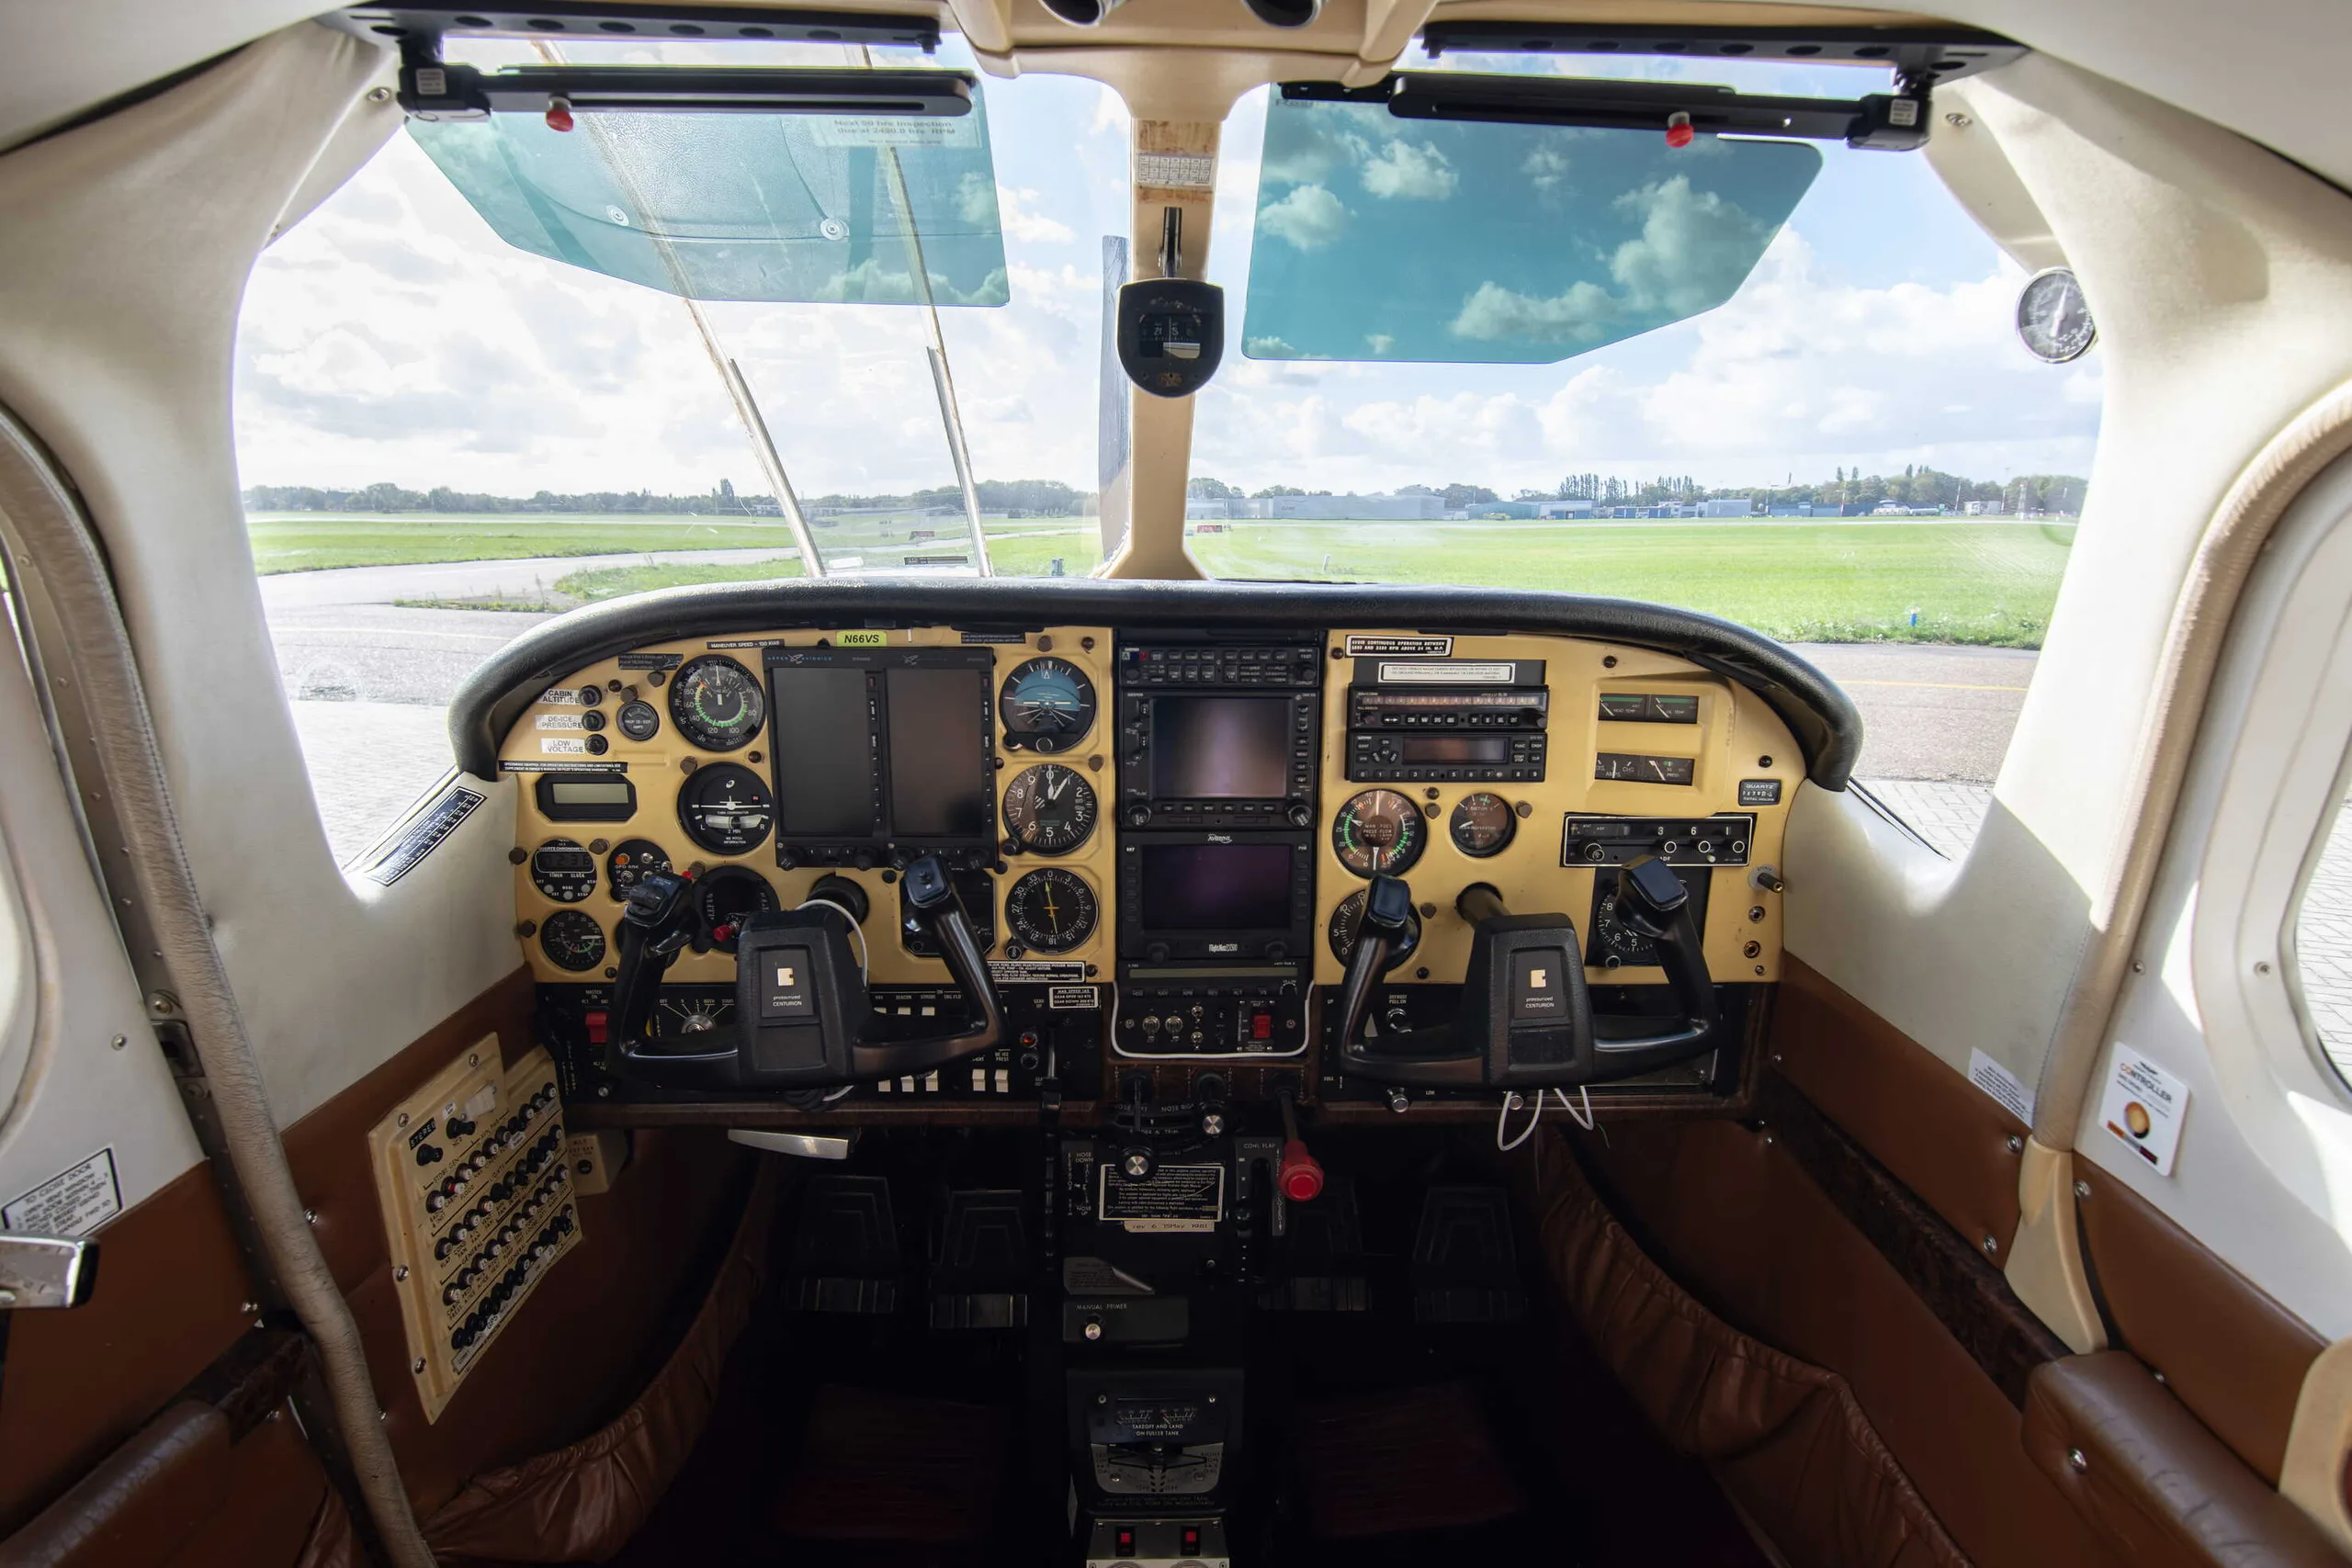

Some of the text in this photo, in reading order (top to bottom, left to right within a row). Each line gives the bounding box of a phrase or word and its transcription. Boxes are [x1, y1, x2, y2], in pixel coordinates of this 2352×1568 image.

[843, 634, 880, 644] N66VS
[542, 696, 580, 705] ALTITUDE
[748, 709, 758, 717] 80
[548, 716, 573, 724] DE-ICE
[1027, 776, 1035, 785] 9
[1016, 789, 1023, 799] 8
[1076, 787, 1082, 797] 2
[1015, 807, 1023, 818] 7
[1075, 810, 1082, 822] 3
[1028, 820, 1036, 831] 6
[1063, 821, 1070, 831] 4
[1046, 827, 1054, 838] 5
[1657, 827, 1665, 836] 3
[1690, 827, 1698, 836] 6
[1026, 874, 1038, 884] 33
[1014, 887, 1024, 898] 30
[1011, 904, 1020, 914] 27
[1333, 929, 1340, 937] 5
[1341, 947, 1348, 955] 0
[2120, 1063, 2174, 1106] CONTROLLER
[1161, 1105, 1181, 1113] NOSE
[39, 1178, 65, 1197] CLOSE
[67, 1163, 92, 1180] DOOR
[487, 1314, 500, 1330] GPS
